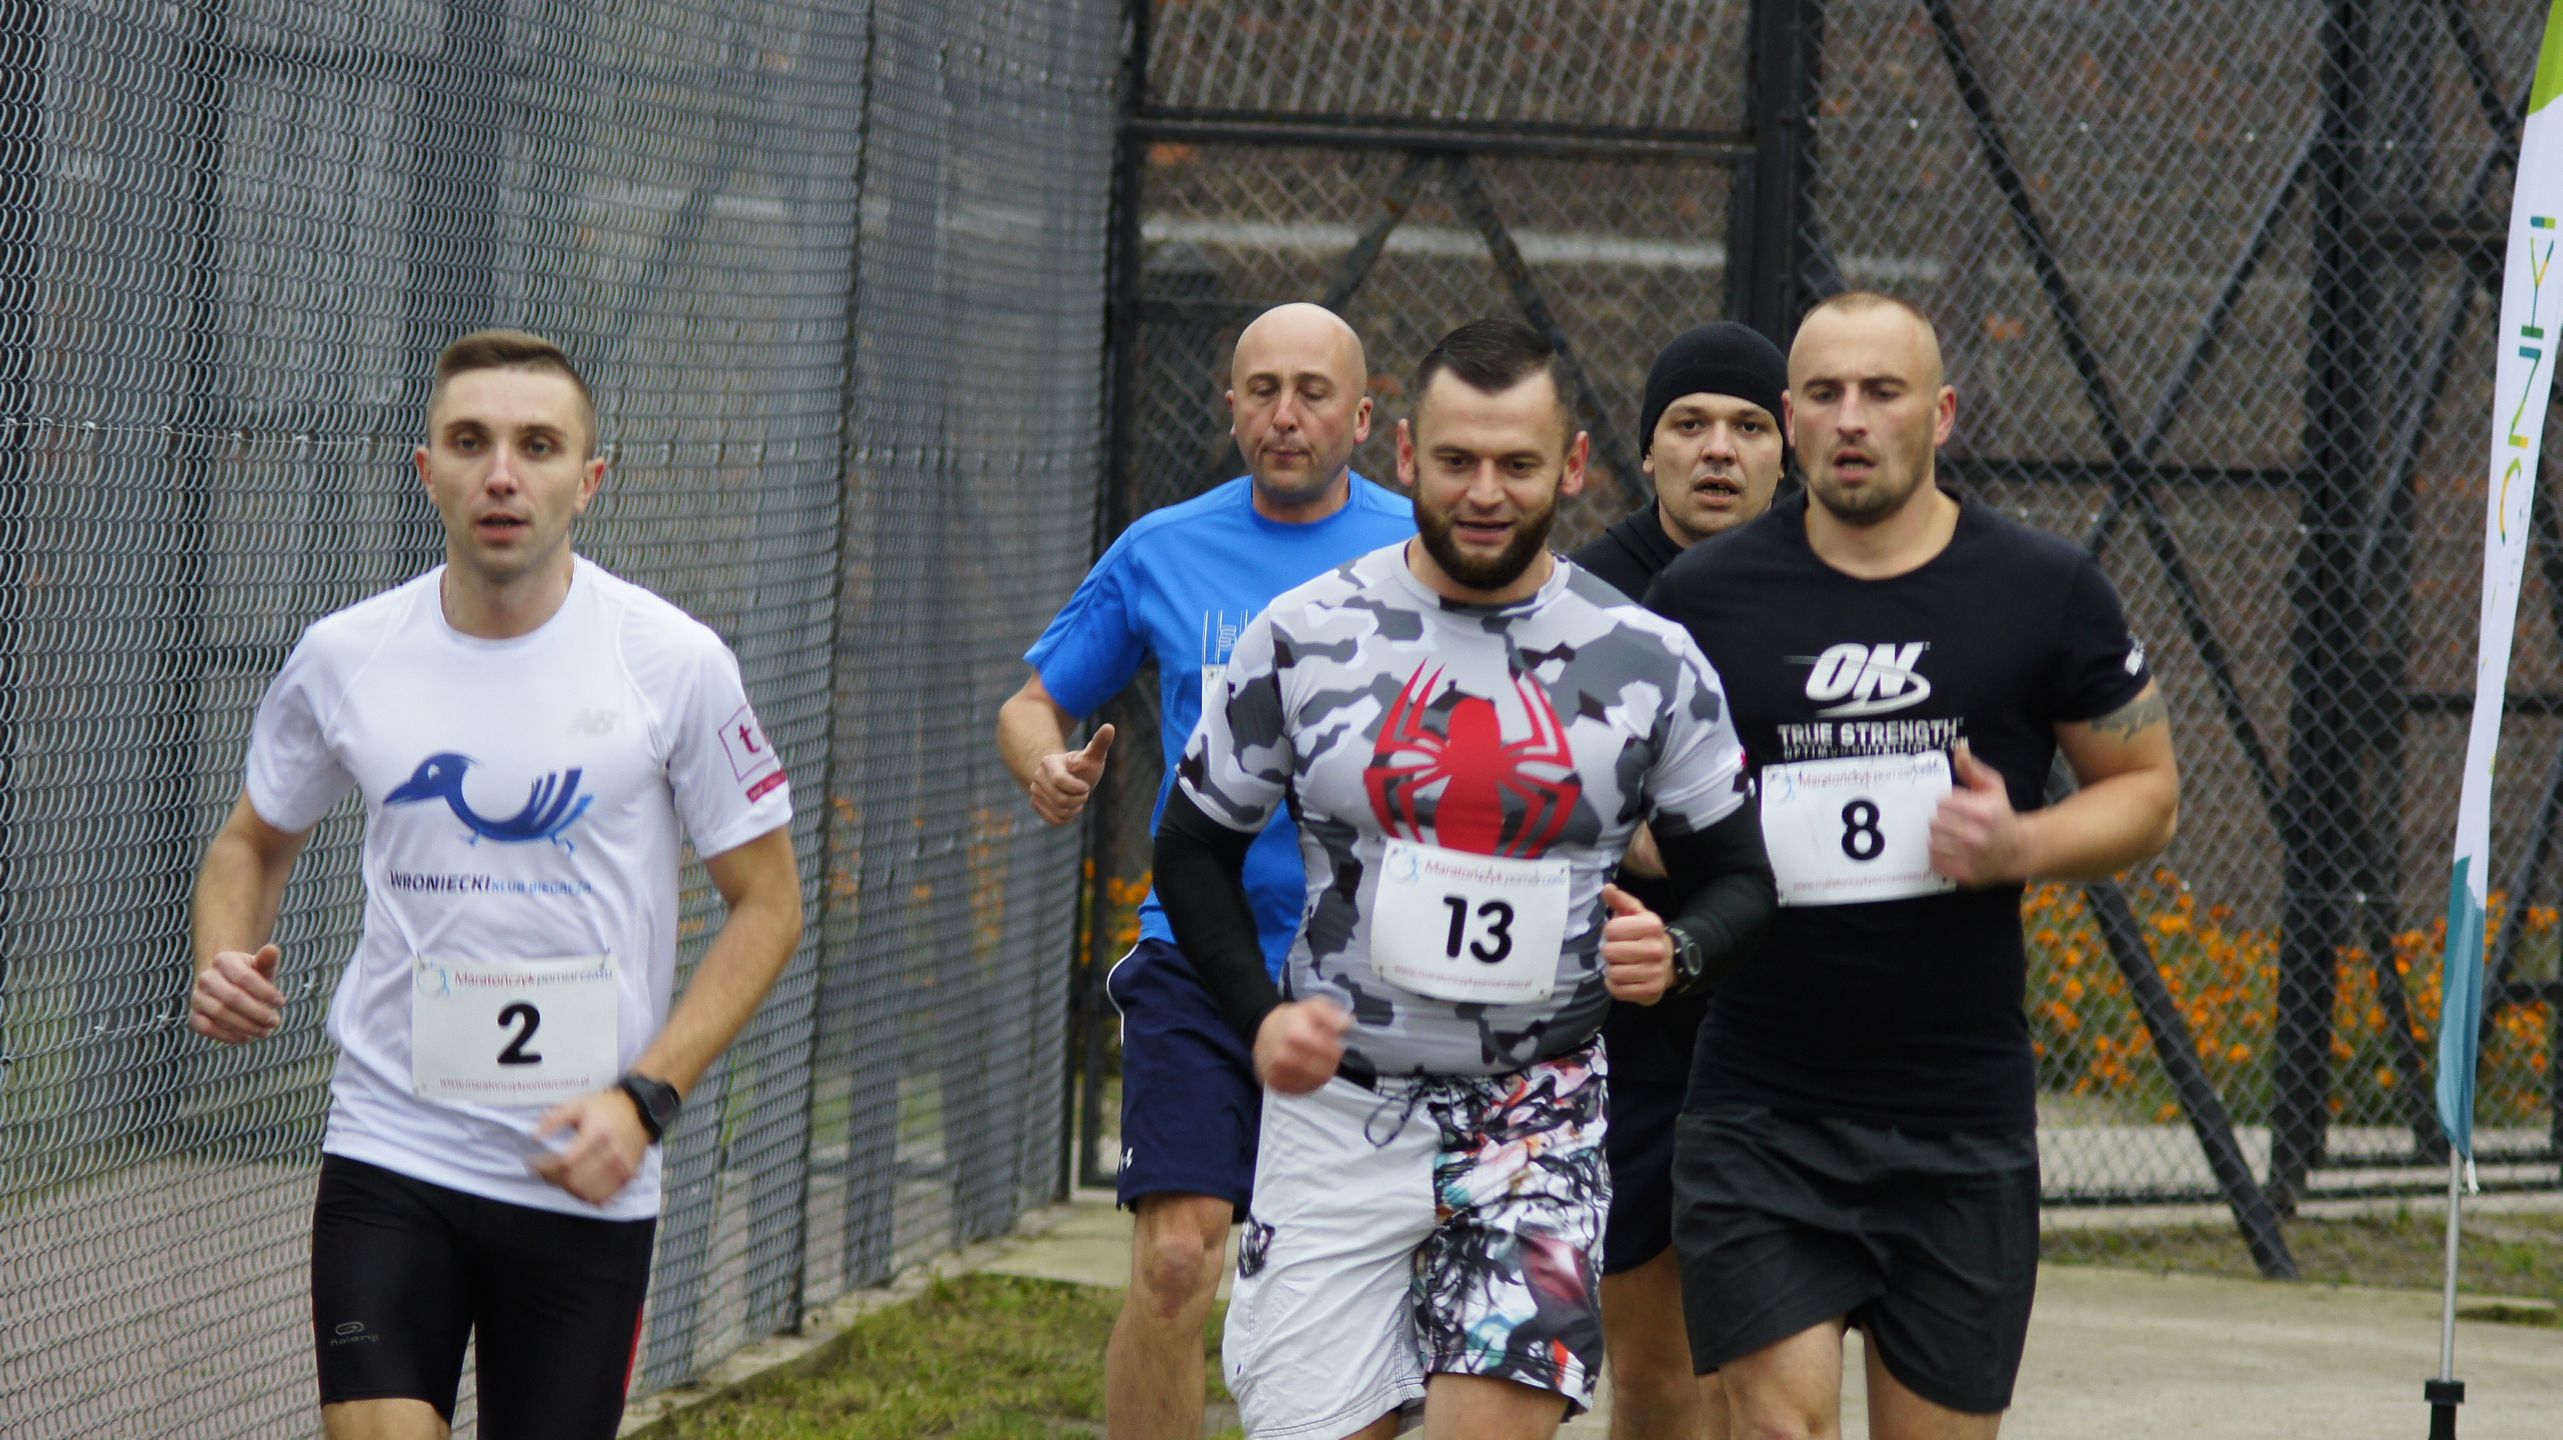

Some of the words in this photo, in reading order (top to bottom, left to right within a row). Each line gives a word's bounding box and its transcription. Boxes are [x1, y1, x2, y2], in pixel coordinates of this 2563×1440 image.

[1805, 641, 1931, 702] ON
[1777, 722, 1833, 749] TRUE
[1840, 718, 1959, 747] STRENGTH
[1841, 799, 1886, 862] 8
[390, 870, 490, 893] WRONIECKI
[1442, 894, 1515, 964] 13
[497, 1002, 543, 1065] 2
